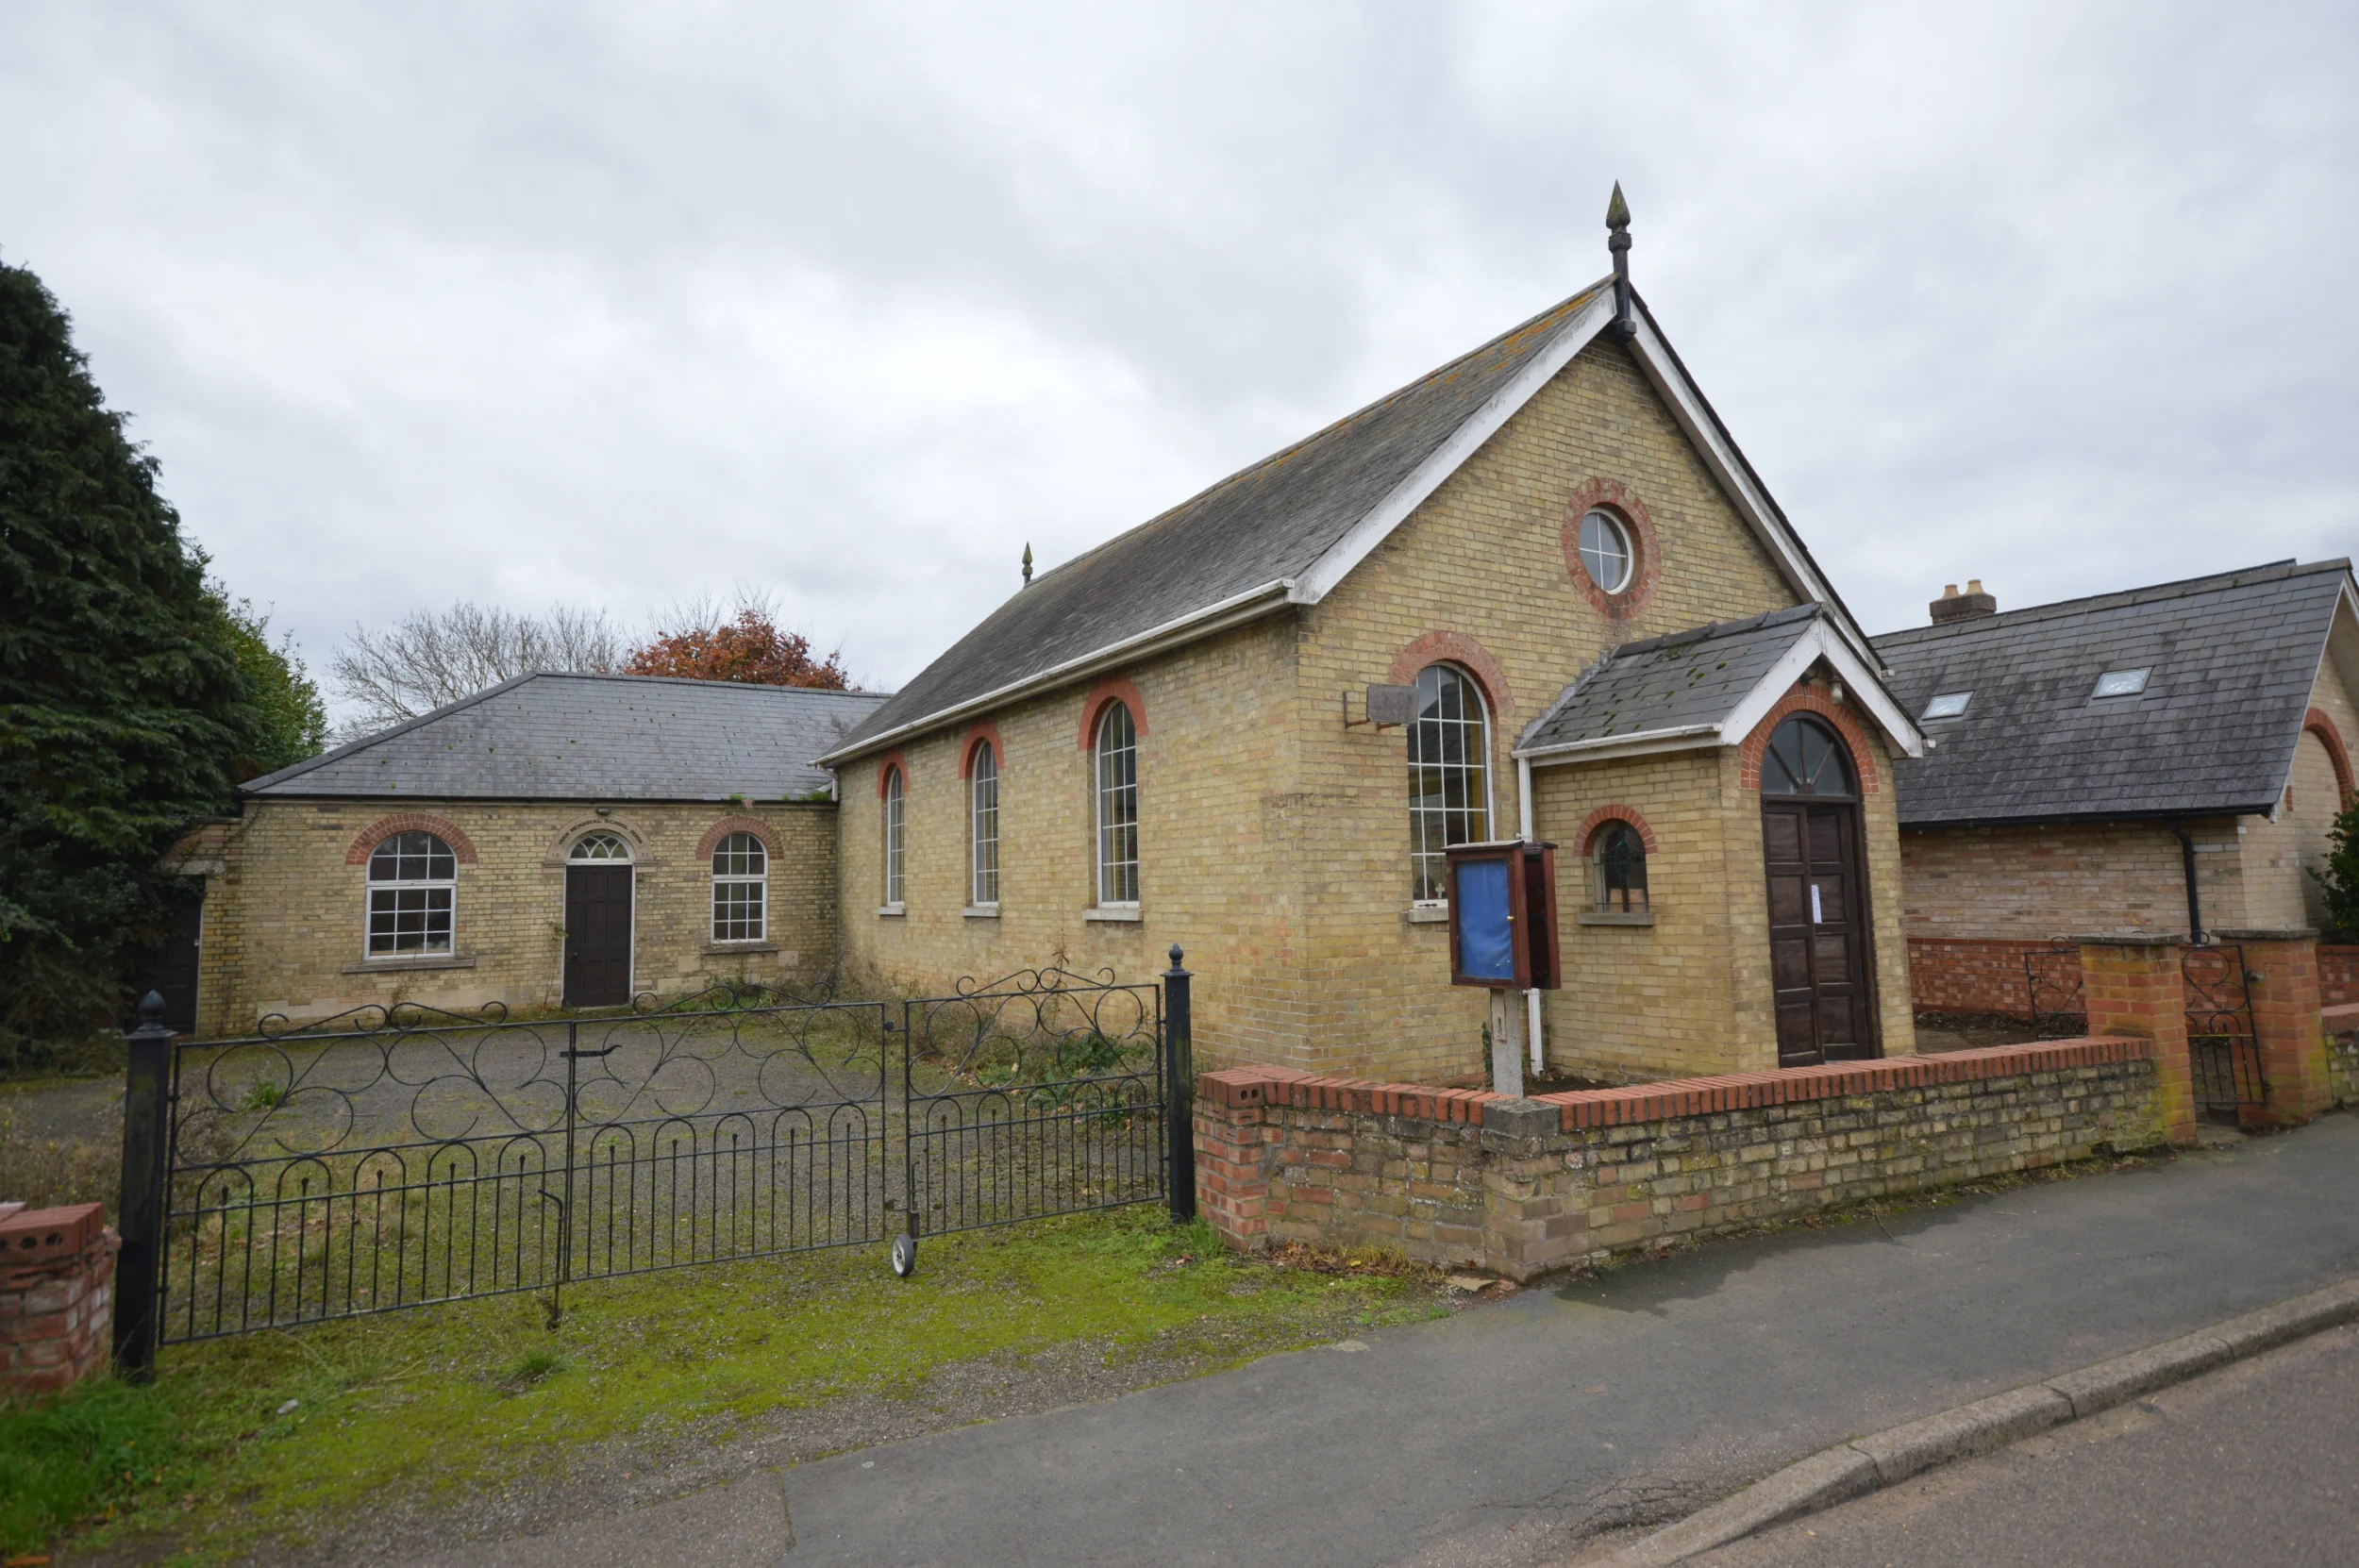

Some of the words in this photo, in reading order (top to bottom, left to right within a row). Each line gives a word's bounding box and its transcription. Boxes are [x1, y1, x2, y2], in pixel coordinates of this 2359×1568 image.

[570, 819, 601, 832] MEMORIAL
[605, 819, 628, 830] SCHOOL
[630, 829, 643, 844] ROOM
